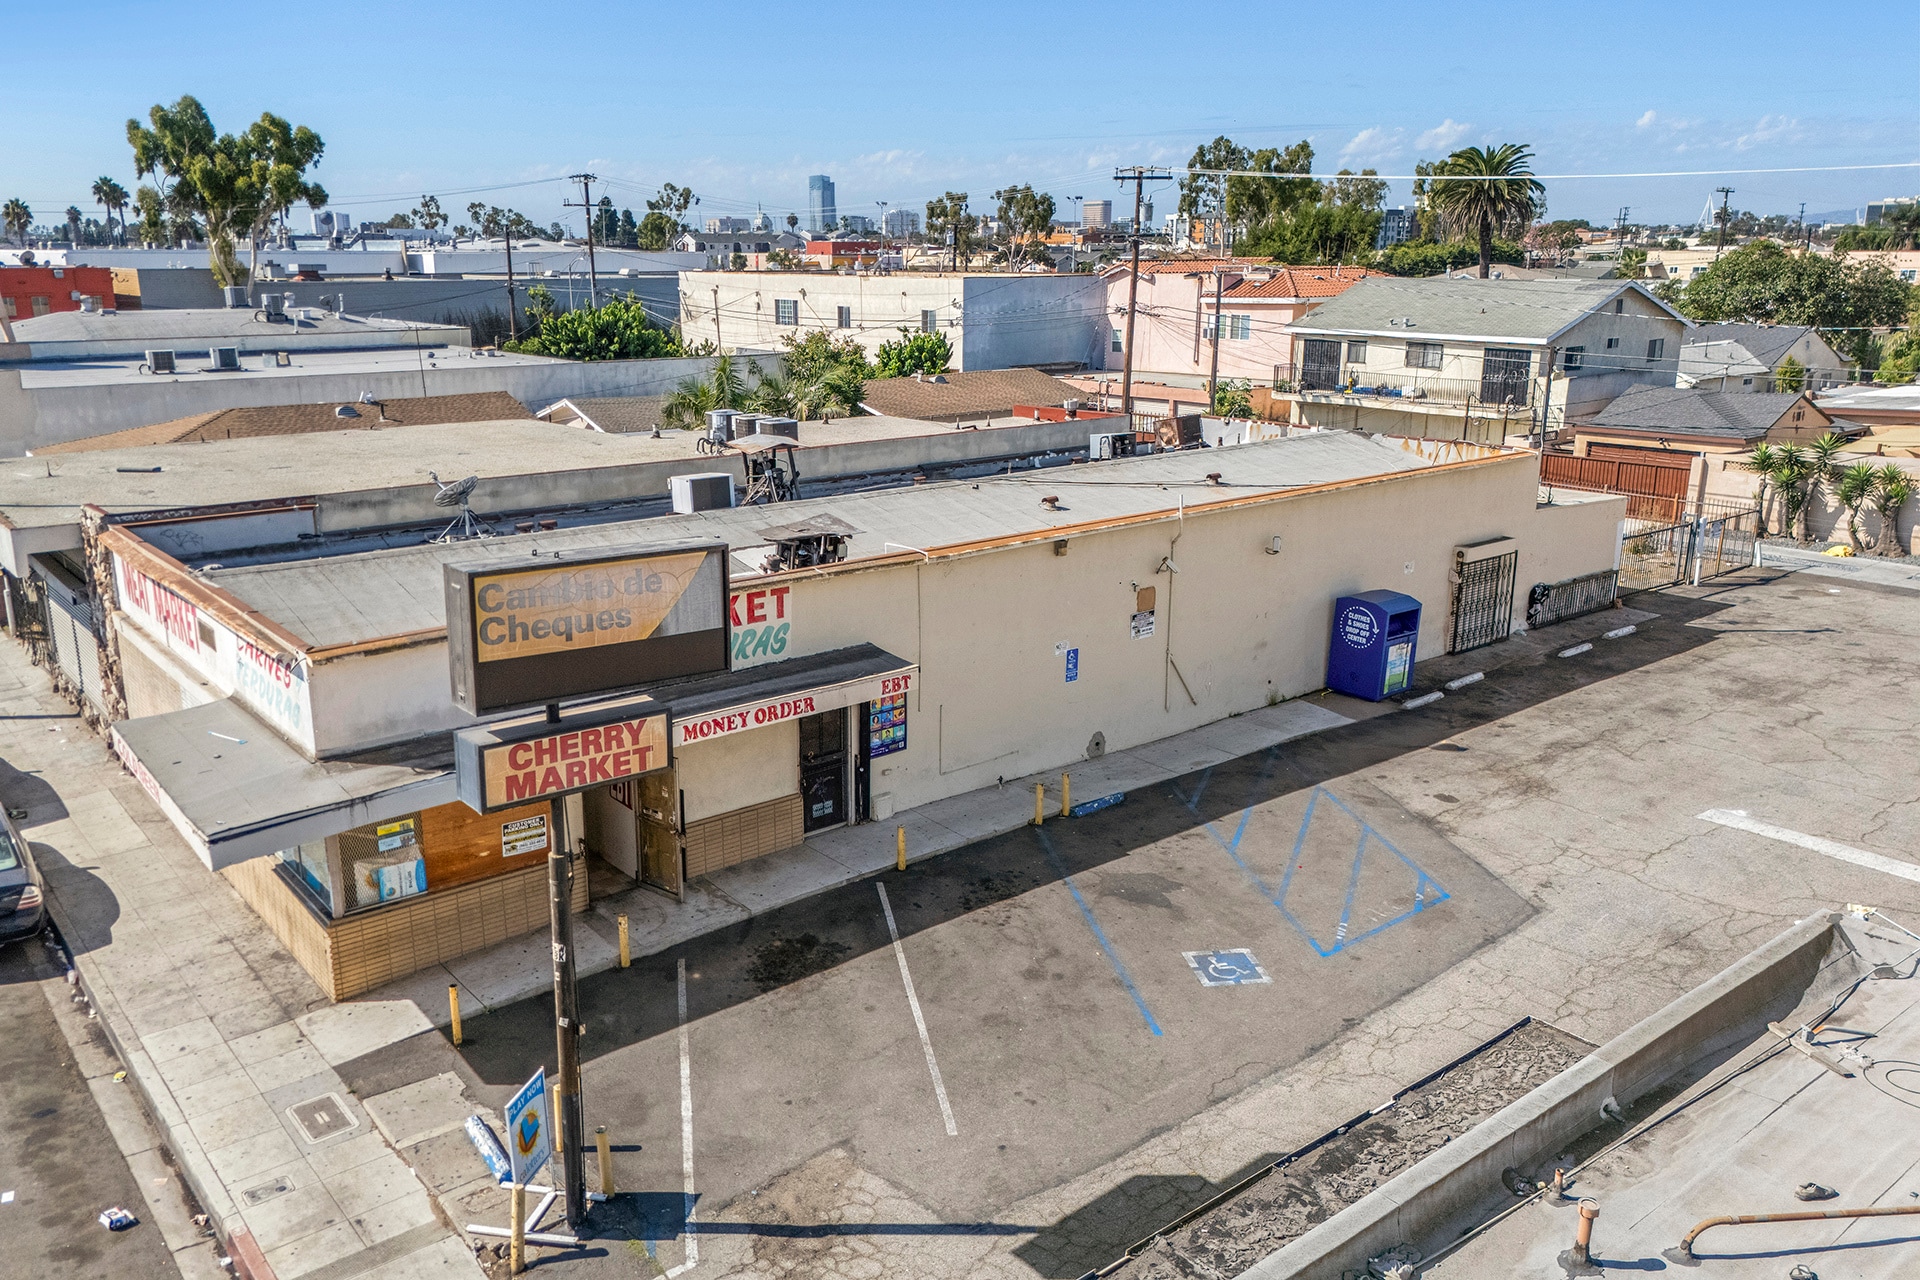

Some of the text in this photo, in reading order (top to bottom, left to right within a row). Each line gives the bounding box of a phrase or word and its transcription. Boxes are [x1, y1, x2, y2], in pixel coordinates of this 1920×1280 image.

[121, 560, 200, 654] MEAT MARKET
[477, 568, 663, 613] Cambio de
[479, 608, 632, 646] Cheques
[1345, 625, 1370, 637] DROP OFF
[1348, 612, 1371, 624] CLOTHES
[1352, 620, 1369, 630] SHOES
[1347, 633, 1367, 644] CENTER
[236, 637, 292, 689] CARNES
[881, 674, 911, 695] EBT
[682, 696, 815, 742] MONEY ORDER
[508, 719, 647, 771] CHERRY
[505, 745, 653, 802] MARKET
[508, 818, 540, 829] CUSTOMER
[509, 1077, 542, 1118] PLAY NOW
